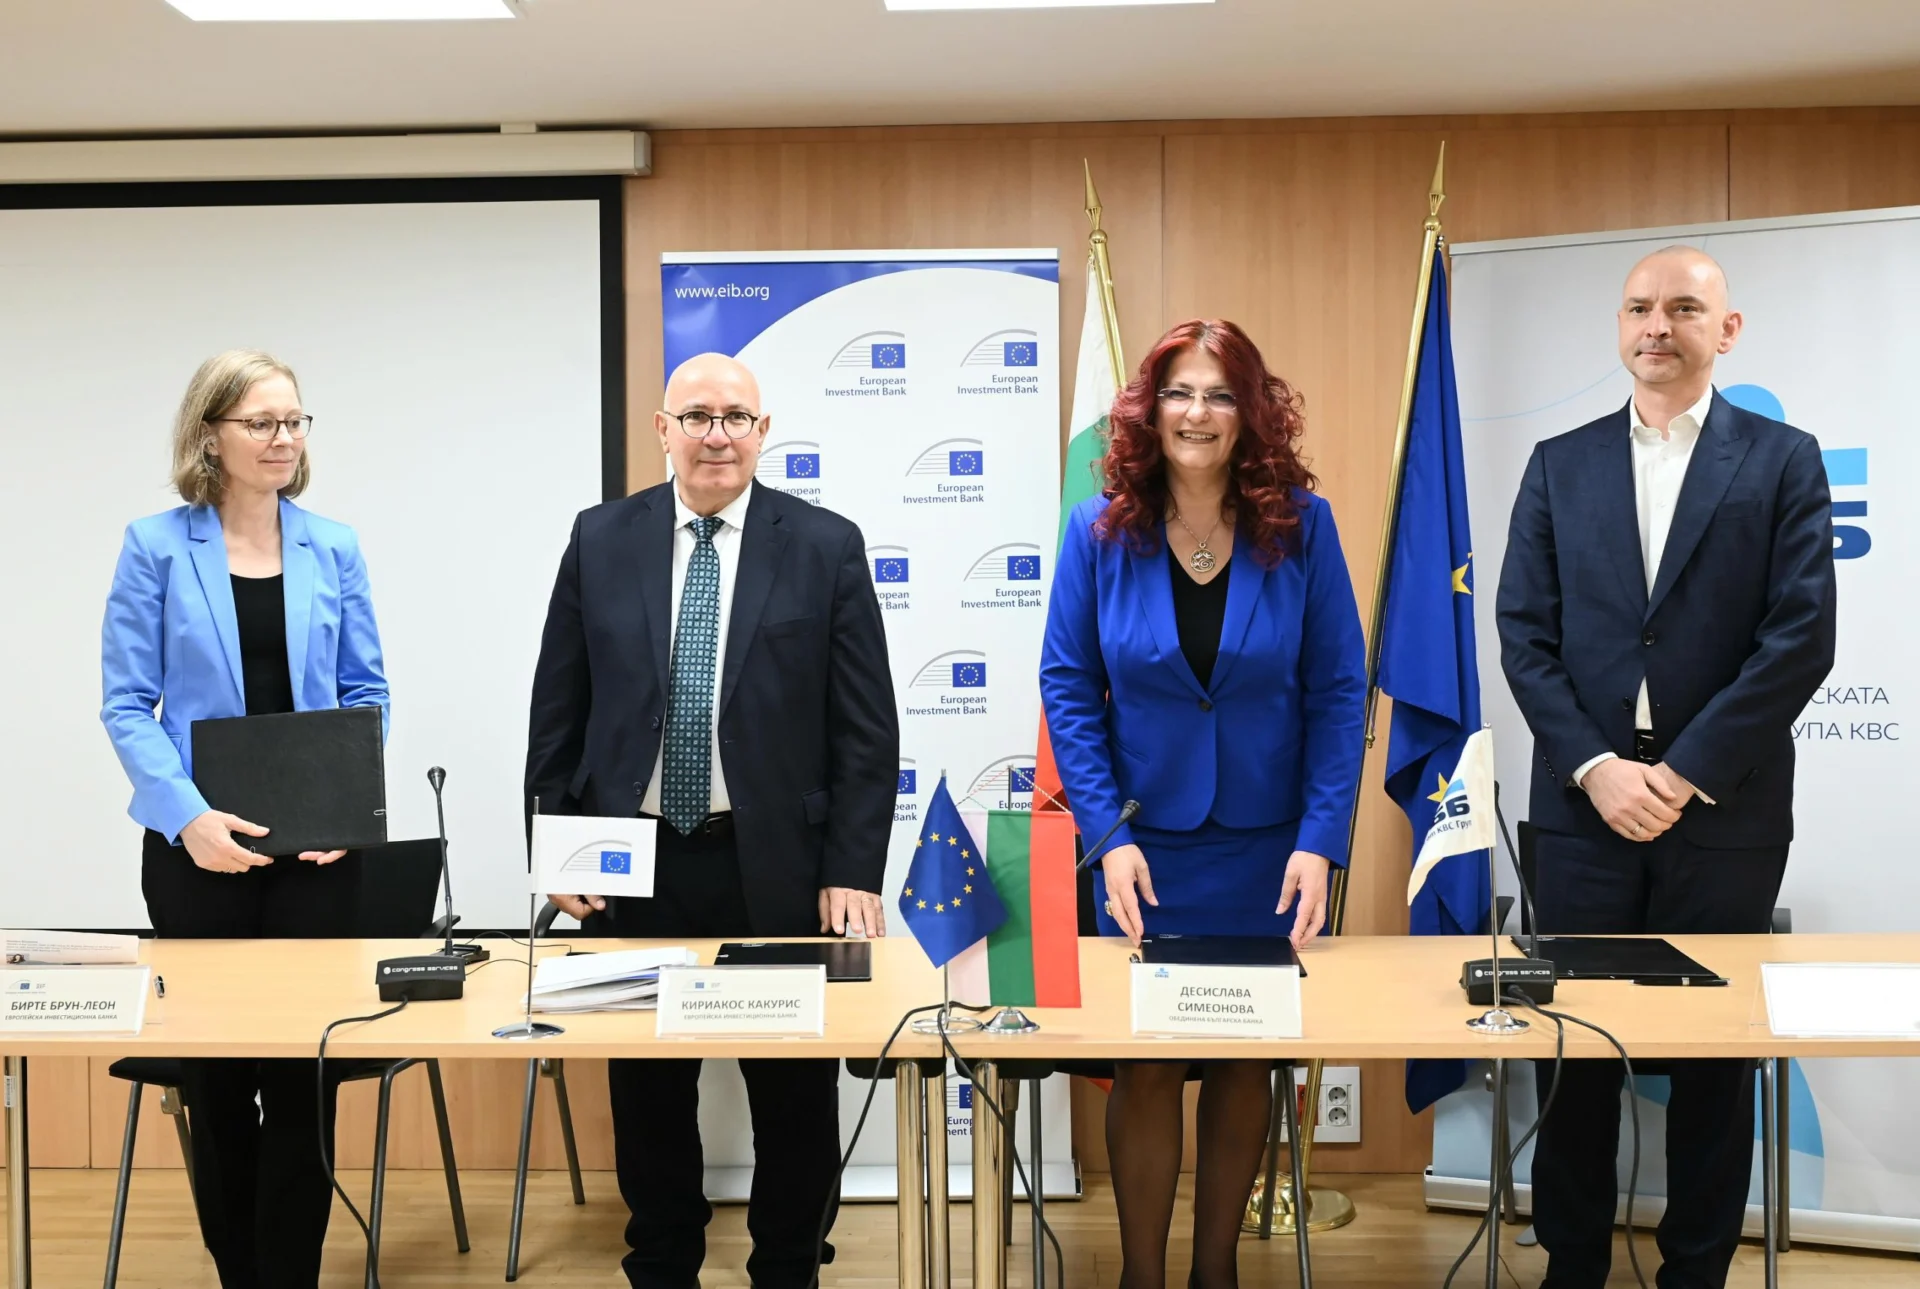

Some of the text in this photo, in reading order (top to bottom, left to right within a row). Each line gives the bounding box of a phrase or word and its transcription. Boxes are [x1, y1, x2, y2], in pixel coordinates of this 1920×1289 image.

[675, 283, 770, 301] www.eib.org
[859, 376, 906, 386] European
[992, 374, 1038, 384] European
[825, 387, 907, 396] Investment Bank
[957, 385, 1039, 394] Investment Bank
[937, 483, 984, 493] European
[805, 497, 821, 505] ank
[903, 494, 984, 503] Investment Bank
[875, 591, 910, 599] ropean
[995, 588, 1042, 598] European
[885, 601, 910, 610] Bank
[961, 599, 1042, 608] Investment Bank
[940, 695, 987, 705] European
[1811, 687, 1890, 705] СКАТА
[906, 706, 987, 715] Investment Bank
[1791, 722, 1843, 740] УПА
[998, 800, 1033, 811] Europe
[1180, 986, 1251, 998] ДЕСИСЛАВА
[11, 1000, 116, 1011] БИРТЕ БРУН-ЛЕОН
[681, 999, 801, 1010] КИРИАКОС КАКУРИС
[1178, 1002, 1254, 1014] СИМЕОНОВА
